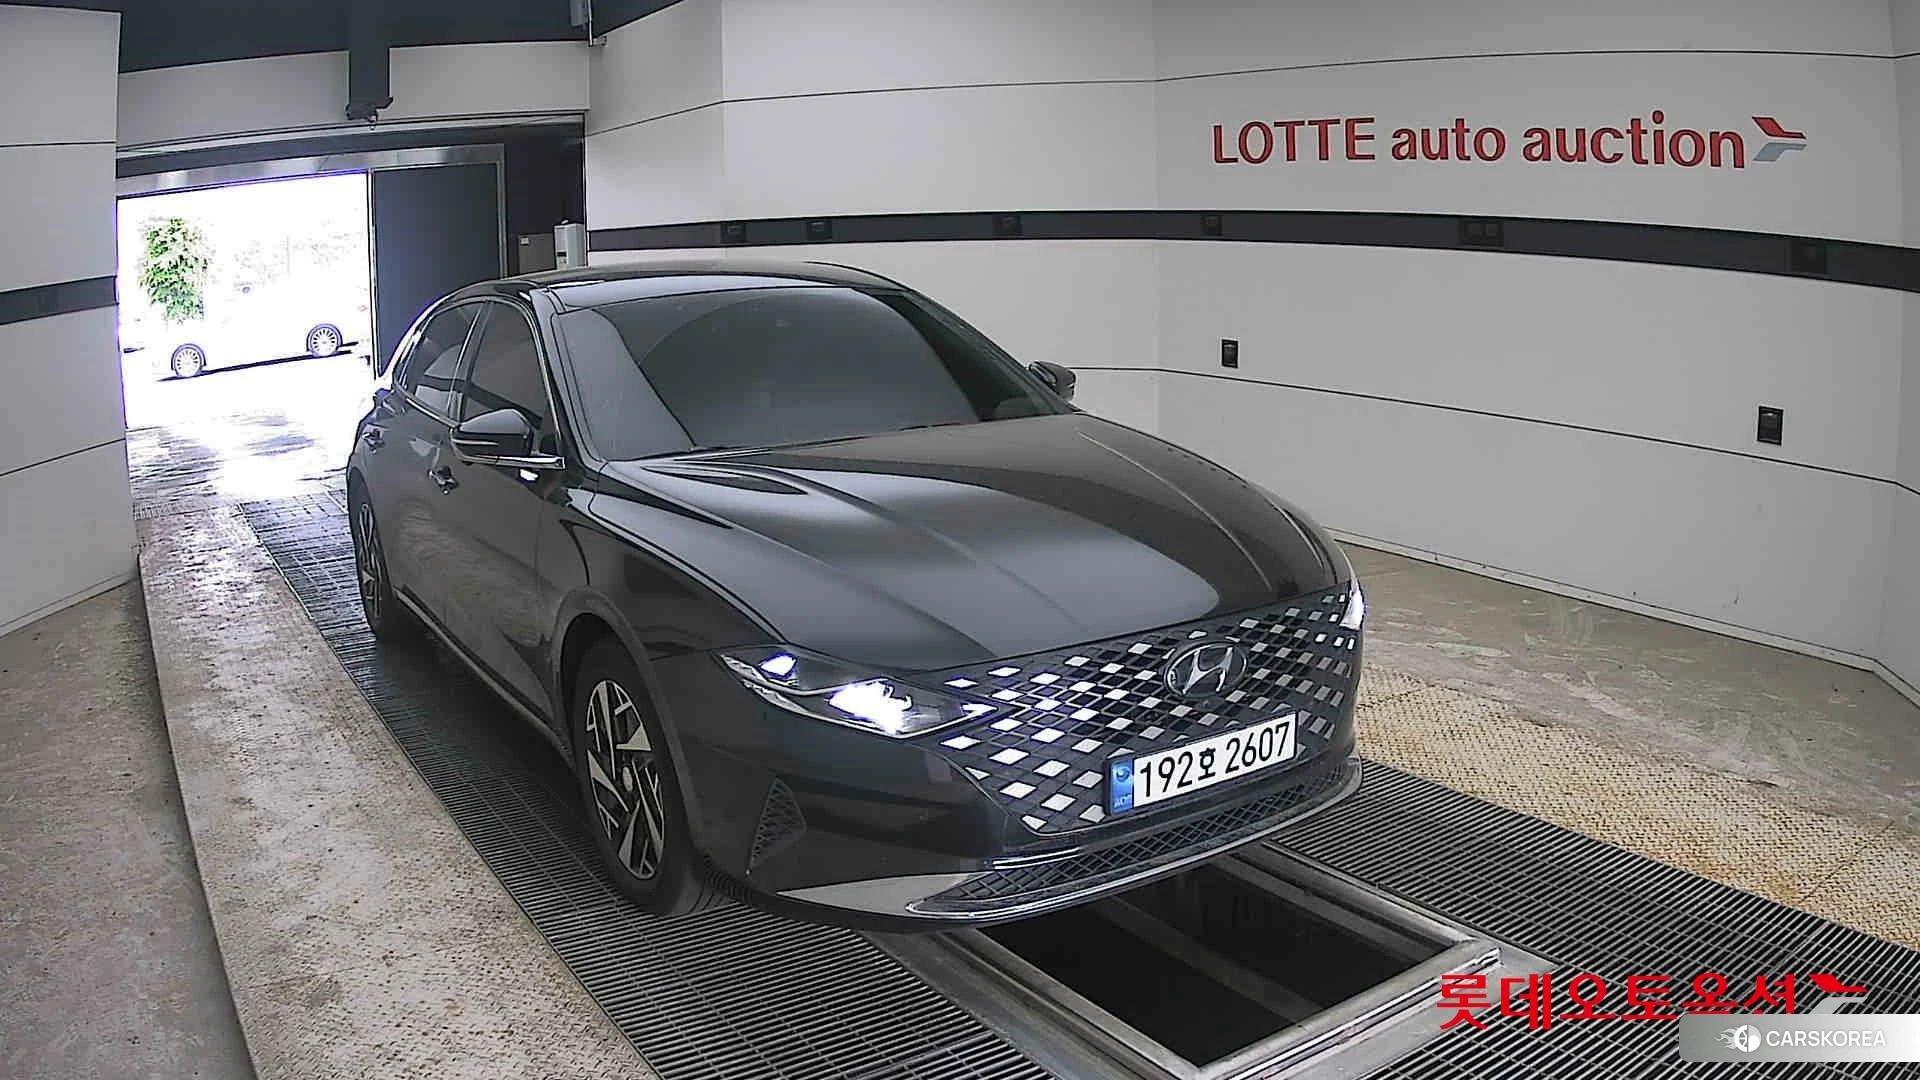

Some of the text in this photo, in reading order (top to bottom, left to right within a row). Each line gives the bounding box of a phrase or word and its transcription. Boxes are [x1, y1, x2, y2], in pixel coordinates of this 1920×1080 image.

[1213, 110, 1745, 169] LOTTE auto auction
[1139, 721, 1290, 798] 192호 2607
